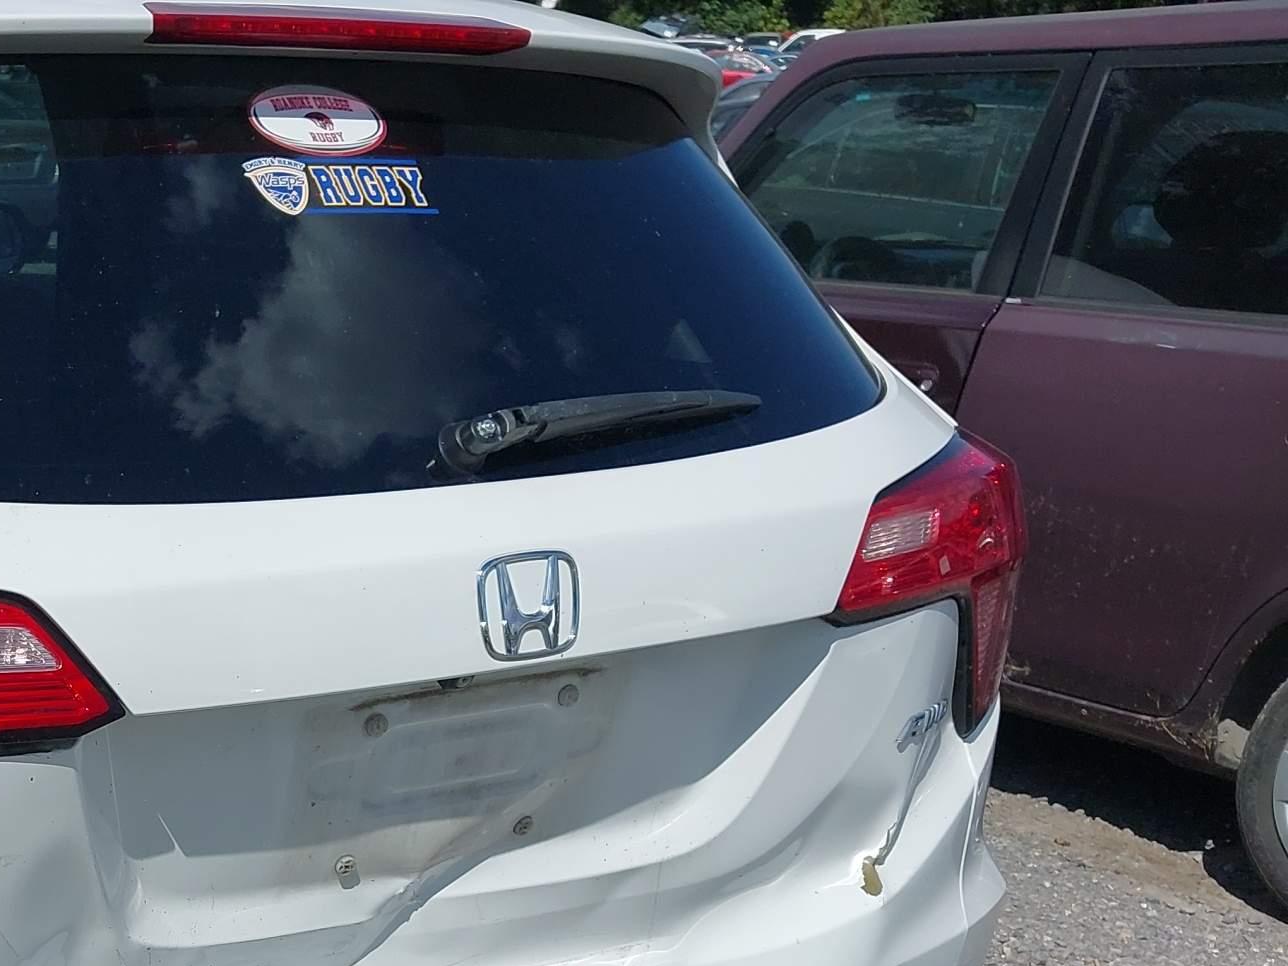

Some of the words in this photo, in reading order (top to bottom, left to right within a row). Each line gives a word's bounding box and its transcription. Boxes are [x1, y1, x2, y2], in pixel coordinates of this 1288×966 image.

[312, 96, 354, 112] COLLEGE
[309, 131, 345, 143] RUGBY
[255, 173, 305, 189] Wasps
[309, 166, 428, 206] RUGBY
